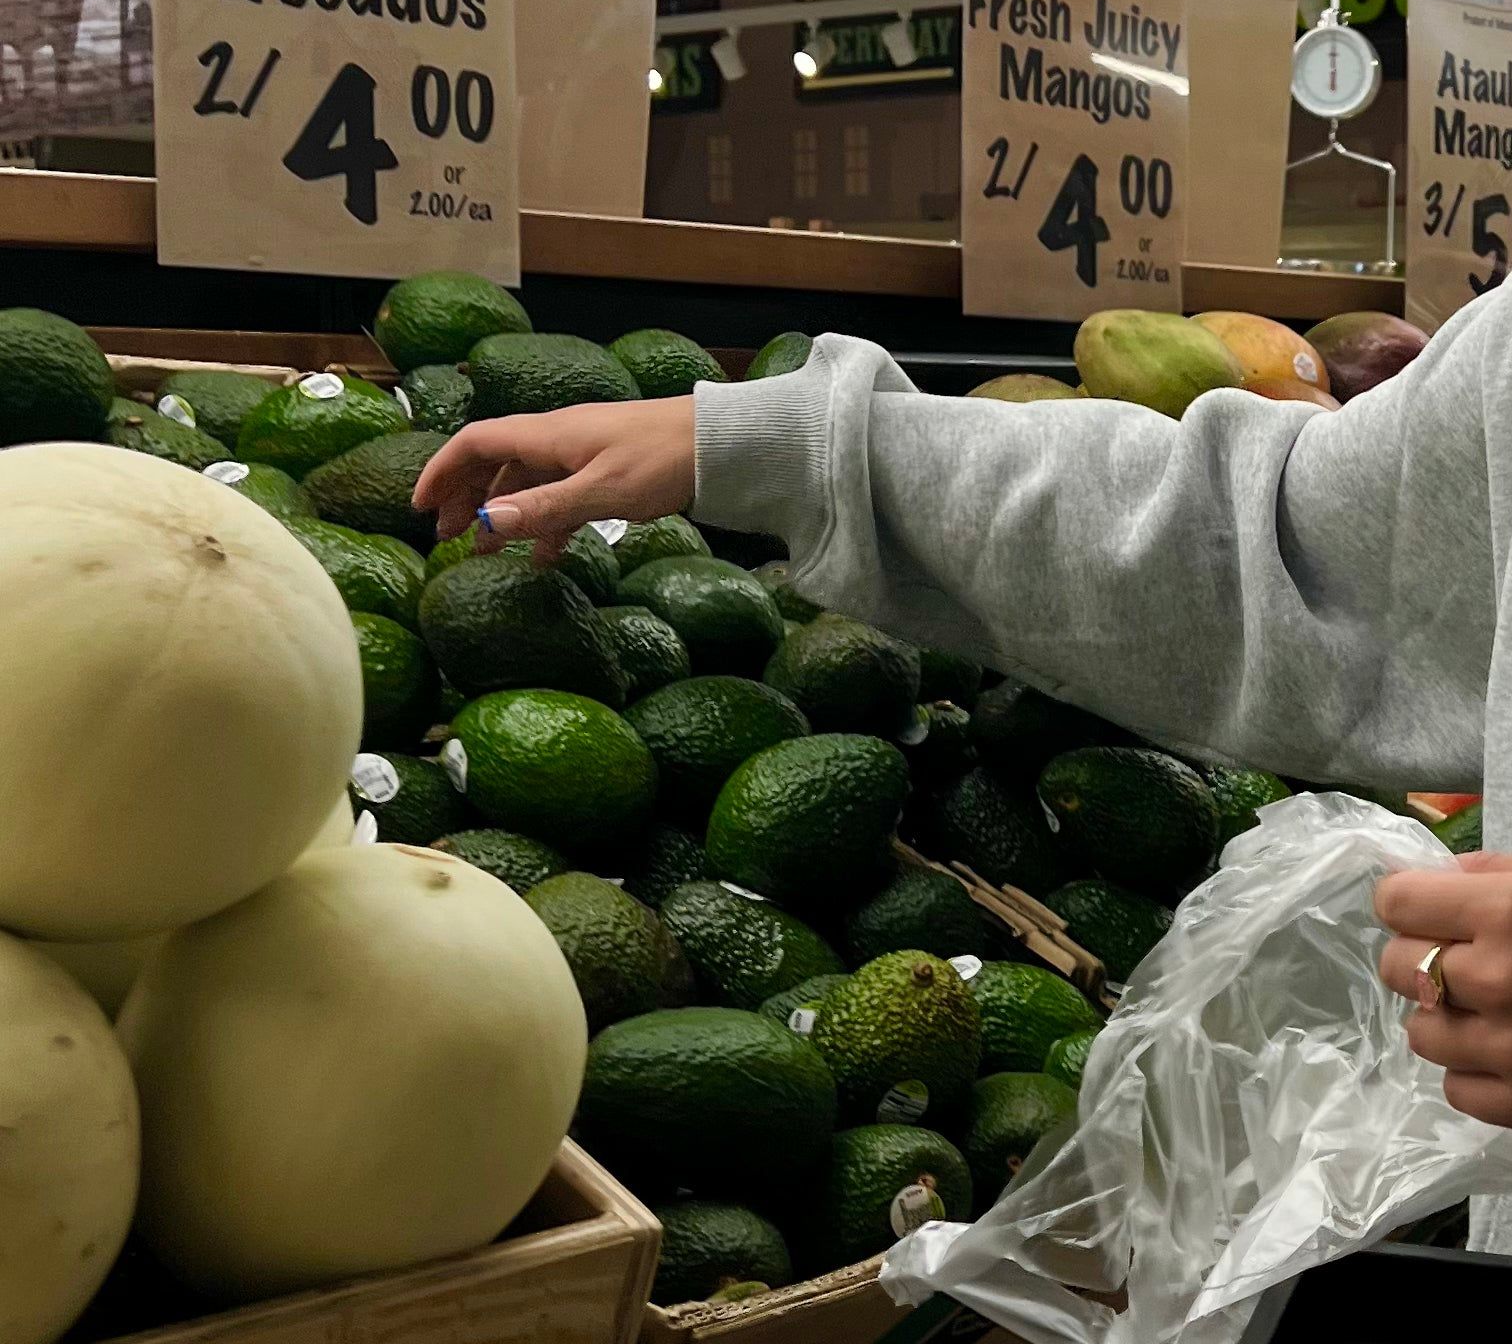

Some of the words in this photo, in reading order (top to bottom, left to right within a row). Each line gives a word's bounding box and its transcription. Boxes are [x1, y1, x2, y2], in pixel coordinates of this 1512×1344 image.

[1000, 42, 1150, 124] Mangos
[444, 164, 466, 184] or
[409, 190, 493, 222] 2.00/ea
[1139, 238, 1153, 252] or
